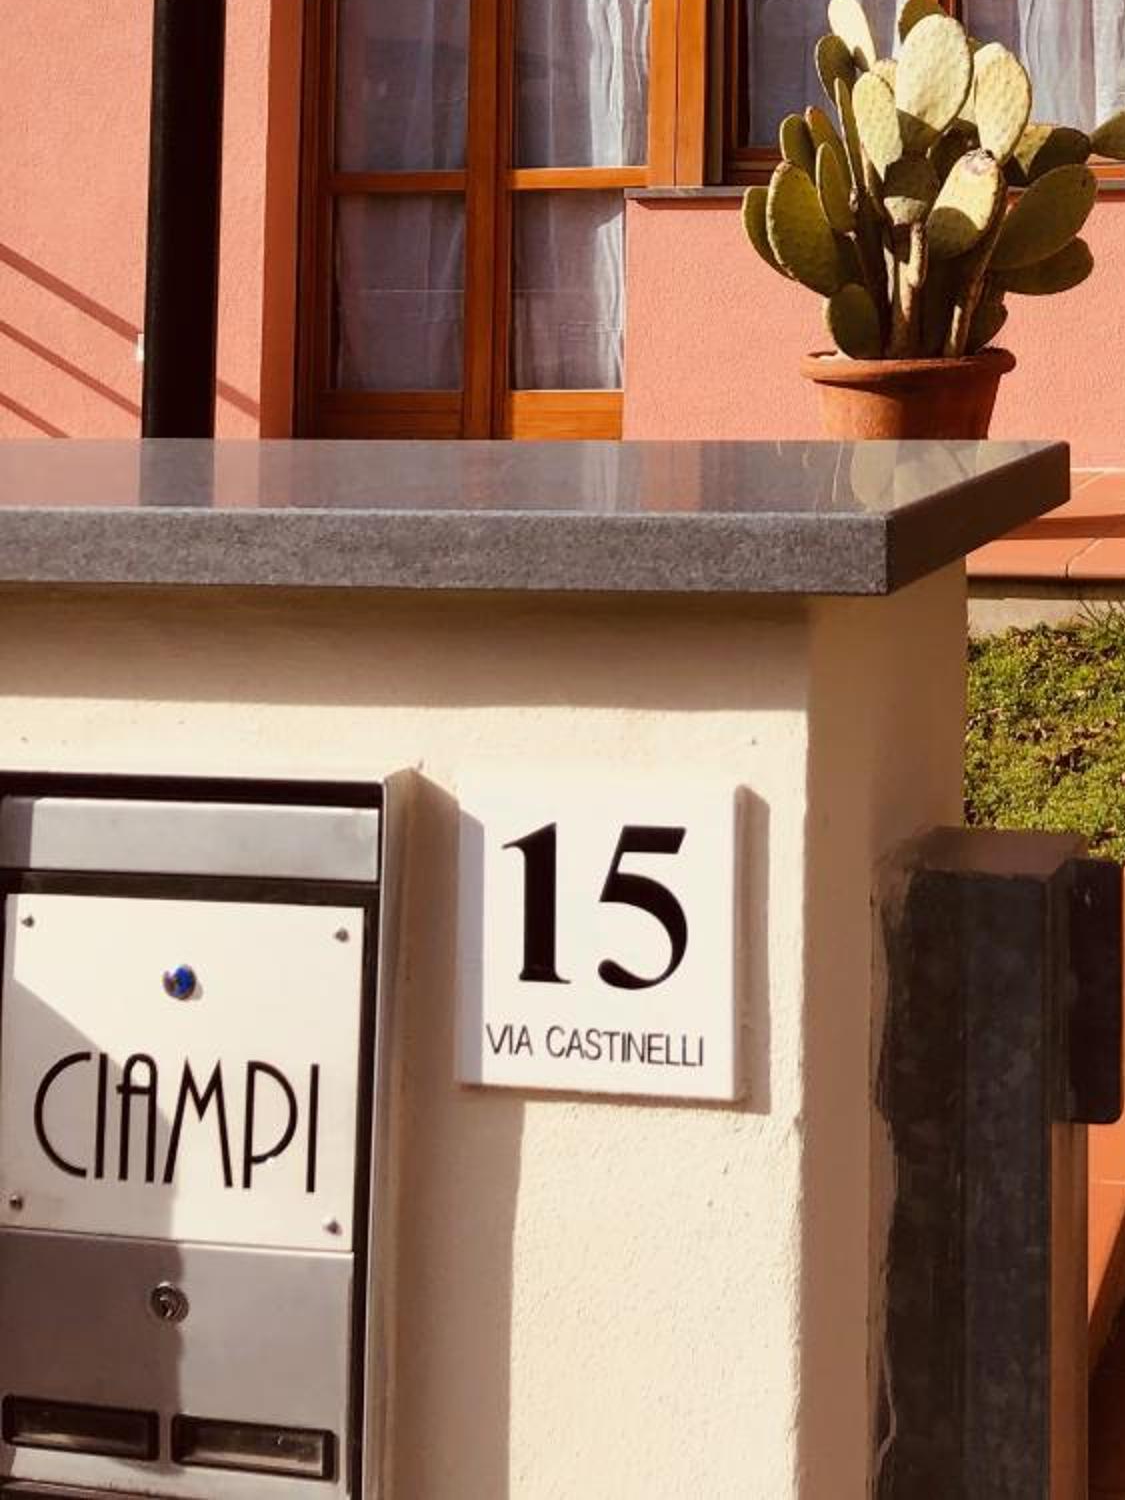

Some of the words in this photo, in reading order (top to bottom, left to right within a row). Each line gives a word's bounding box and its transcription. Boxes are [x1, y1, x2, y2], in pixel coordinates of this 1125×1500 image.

[503, 822, 689, 991] 15
[485, 1024, 533, 1056] VIA
[546, 1025, 704, 1068] CASTINELLI
[33, 1050, 320, 1194] CIAMPI
